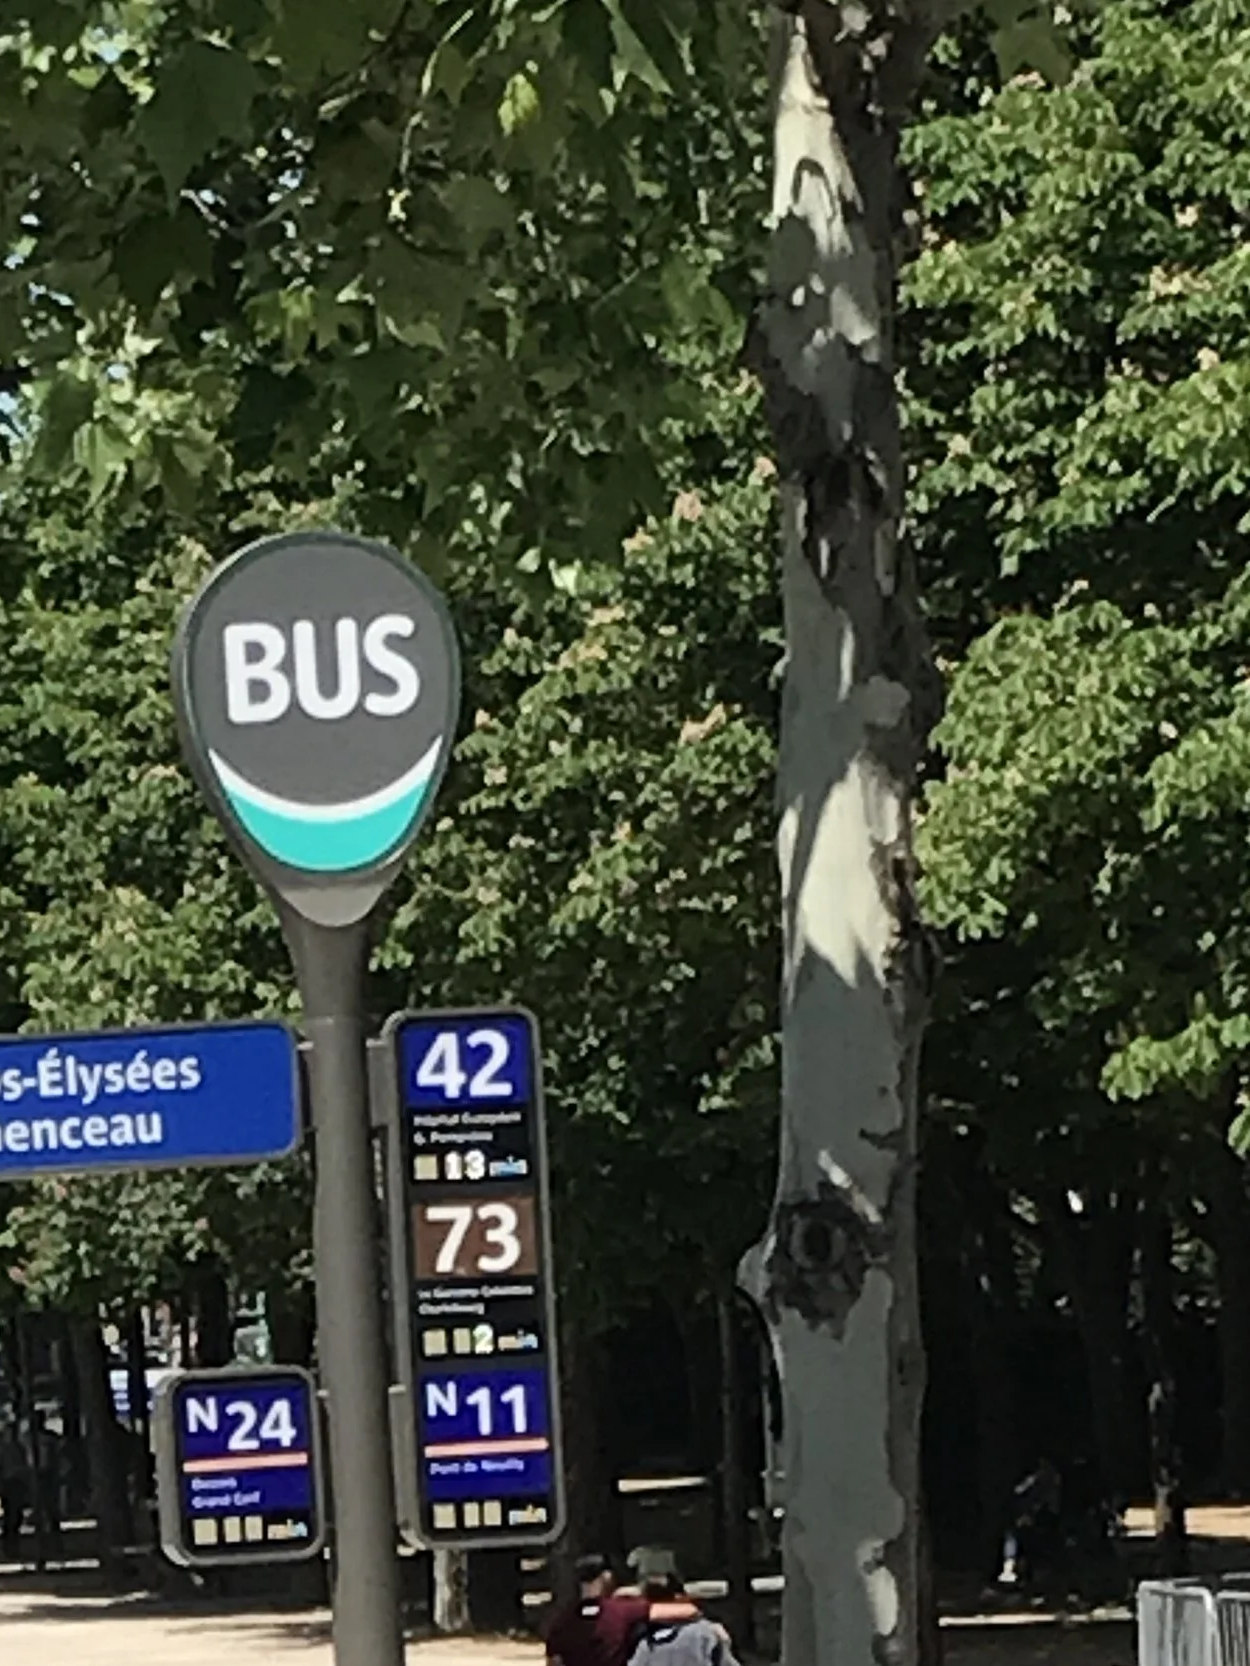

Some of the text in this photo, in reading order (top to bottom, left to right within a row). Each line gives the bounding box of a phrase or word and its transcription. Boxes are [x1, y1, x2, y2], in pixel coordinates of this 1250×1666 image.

[223, 613, 421, 725] BUS
[416, 1029, 513, 1098] 42
[444, 1150, 485, 1180] 13
[425, 1202, 521, 1273] 73
[473, 1323, 494, 1354] 2
